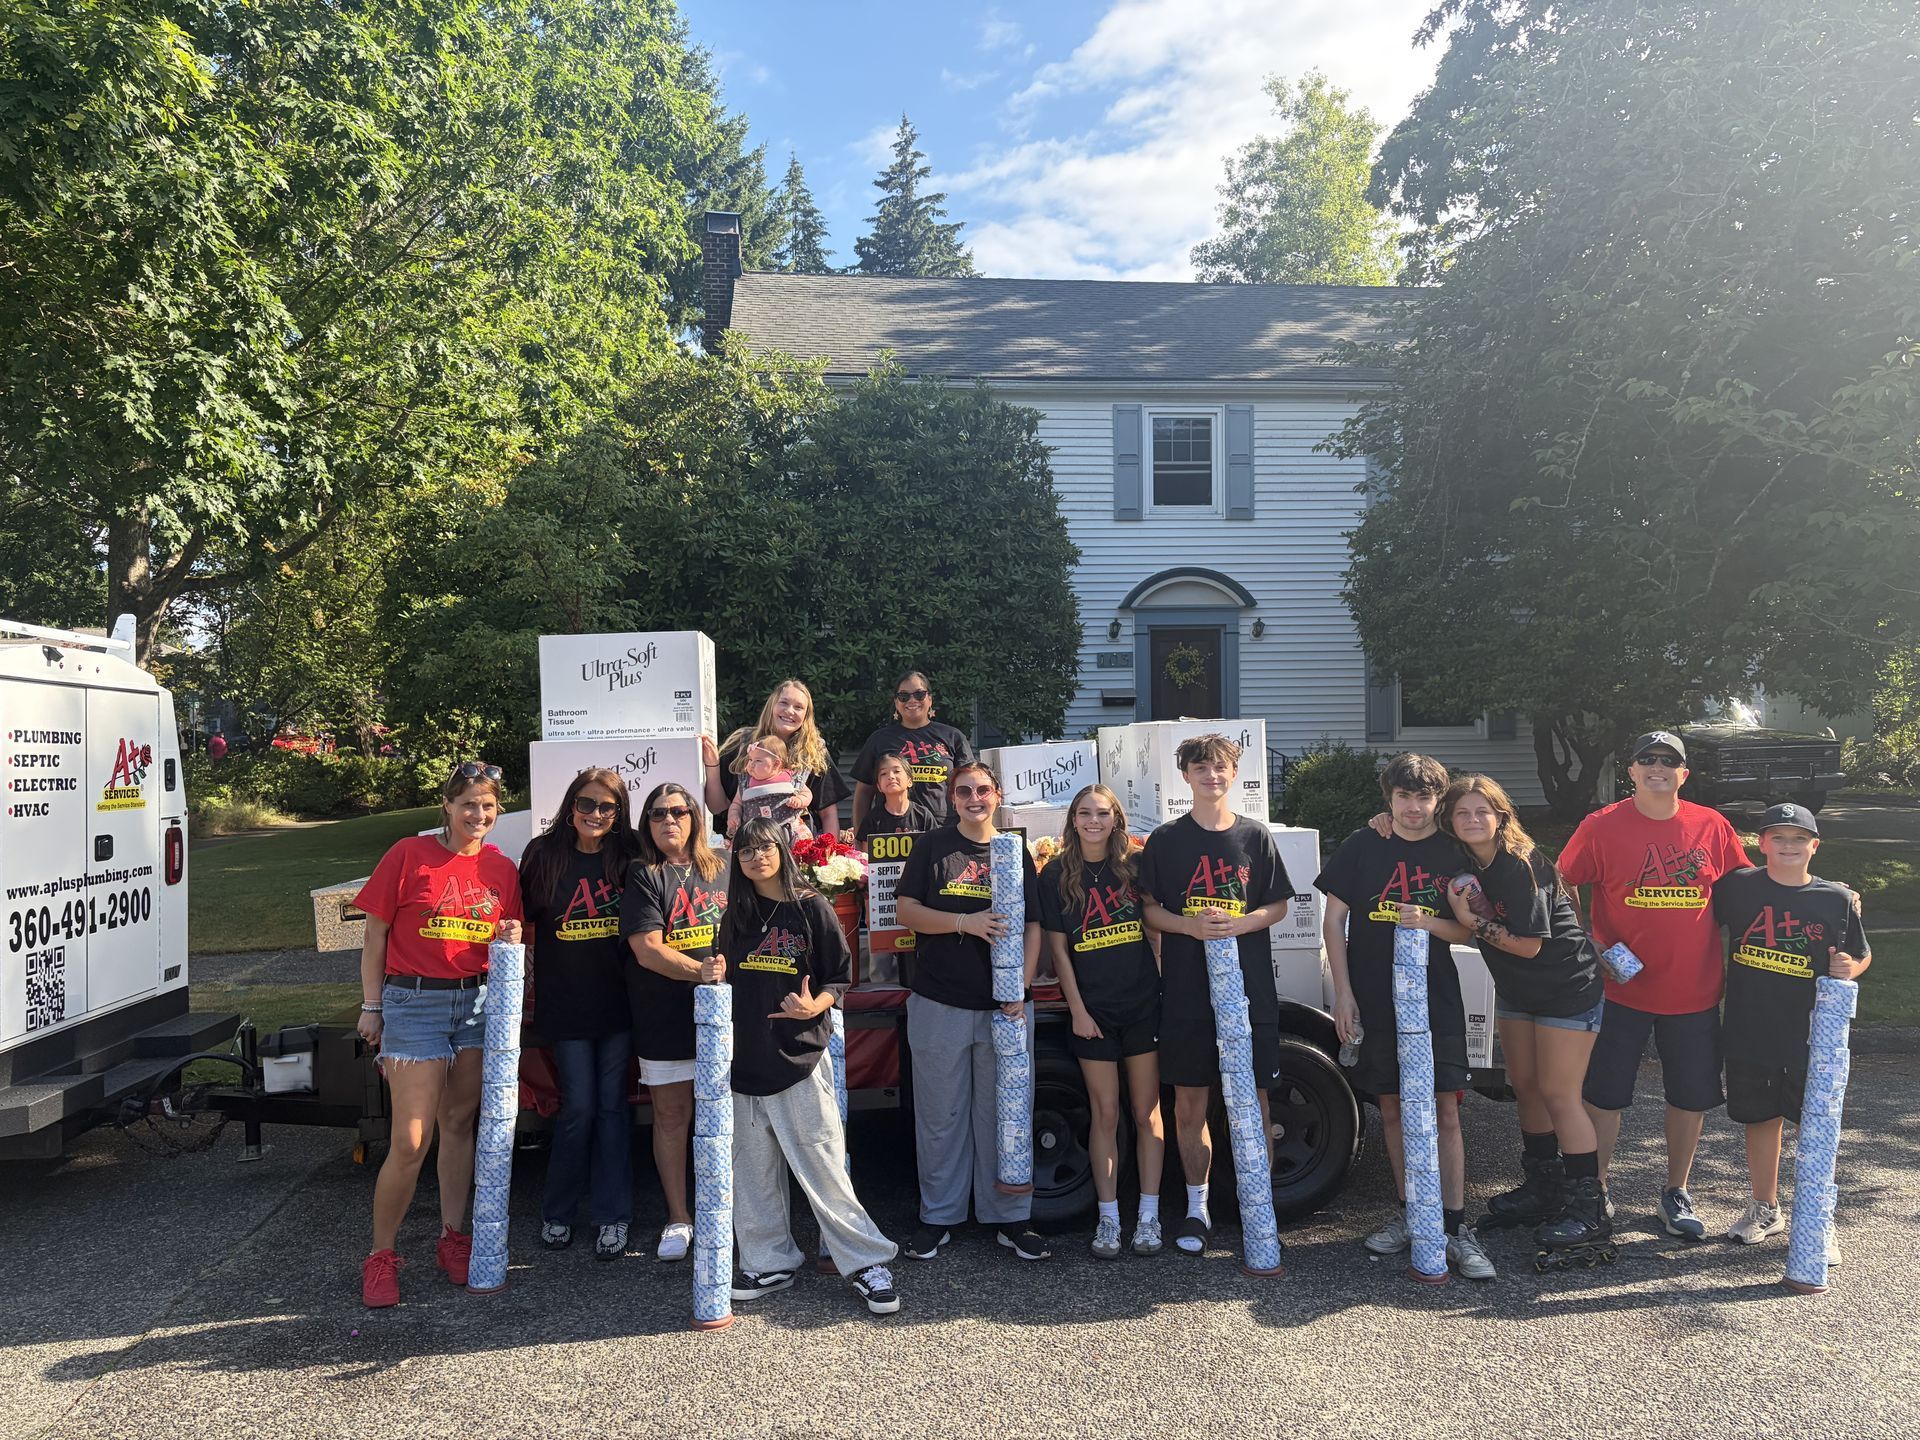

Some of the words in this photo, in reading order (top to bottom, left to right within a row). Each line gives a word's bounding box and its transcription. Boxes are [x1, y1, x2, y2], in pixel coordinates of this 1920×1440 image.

[581, 641, 658, 682] Ultra-Soft
[608, 670, 642, 692] Plus
[548, 709, 588, 717] Bathroom
[548, 718, 575, 726] Tissue
[14, 729, 82, 745] PLUMBING
[606, 727, 651, 736] performance
[14, 754, 60, 768] SEPTIC
[109, 738, 139, 790] A+
[913, 767, 942, 775] VICES
[1015, 750, 1084, 791] Ultra-Soft
[14, 778, 77, 792] ELECTRIC
[1041, 778, 1071, 799] Plus
[104, 788, 140, 800] SERVICES
[14, 802, 50, 818] HVAC
[97, 803, 111, 811] Setting
[872, 836, 913, 859] 800
[877, 865, 900, 876] SEPTIC
[1635, 843, 1687, 888] A+
[7, 865, 152, 900] www.aplusplumbing.com
[878, 879, 900, 888] PLUM
[1186, 855, 1232, 898] A+
[1379, 861, 1430, 902] A+
[430, 875, 481, 917] A+
[949, 883, 990, 893] SERVICES
[1638, 888, 1698, 898] SERVICES
[563, 878, 613, 922] A+
[878, 892, 895, 901] ELEC
[1188, 898, 1239, 911] SERVICES
[1627, 899, 1648, 907] Setting
[667, 886, 709, 933] A+
[1082, 885, 1121, 932] A+
[9, 886, 151, 953] 360-491-2900
[431, 918, 490, 933] SERVICES
[565, 919, 617, 931] SERVICE
[1741, 906, 1800, 947] A+
[421, 929, 441, 937] Setting
[668, 927, 713, 941] SERVIC
[1085, 923, 1138, 940] SERVICES
[754, 927, 794, 956] A+
[1107, 937, 1127, 945] Service
[748, 956, 789, 966] SERVICES
[1742, 946, 1805, 967] SERVICES
[1750, 958, 1760, 966] the
[1761, 962, 1785, 972] Service
[1787, 967, 1812, 977] Standard
